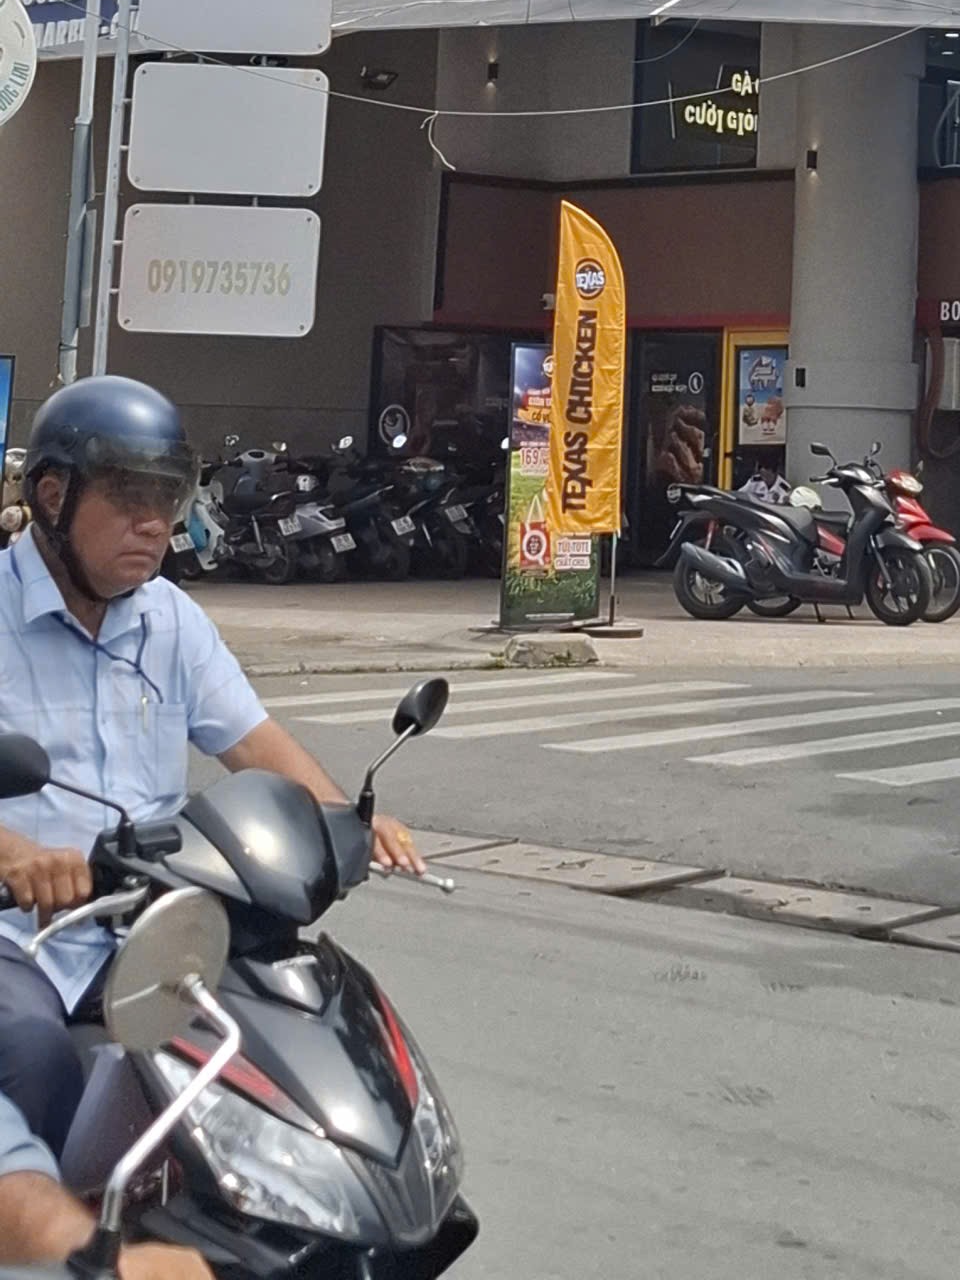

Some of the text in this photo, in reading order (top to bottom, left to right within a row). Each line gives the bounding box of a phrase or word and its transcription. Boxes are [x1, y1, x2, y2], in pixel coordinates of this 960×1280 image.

[148, 259, 291, 296] 0919735736
[576, 271, 605, 290] TEXAS
[565, 309, 598, 425] CHICKEN
[562, 431, 592, 514] TEXAS
